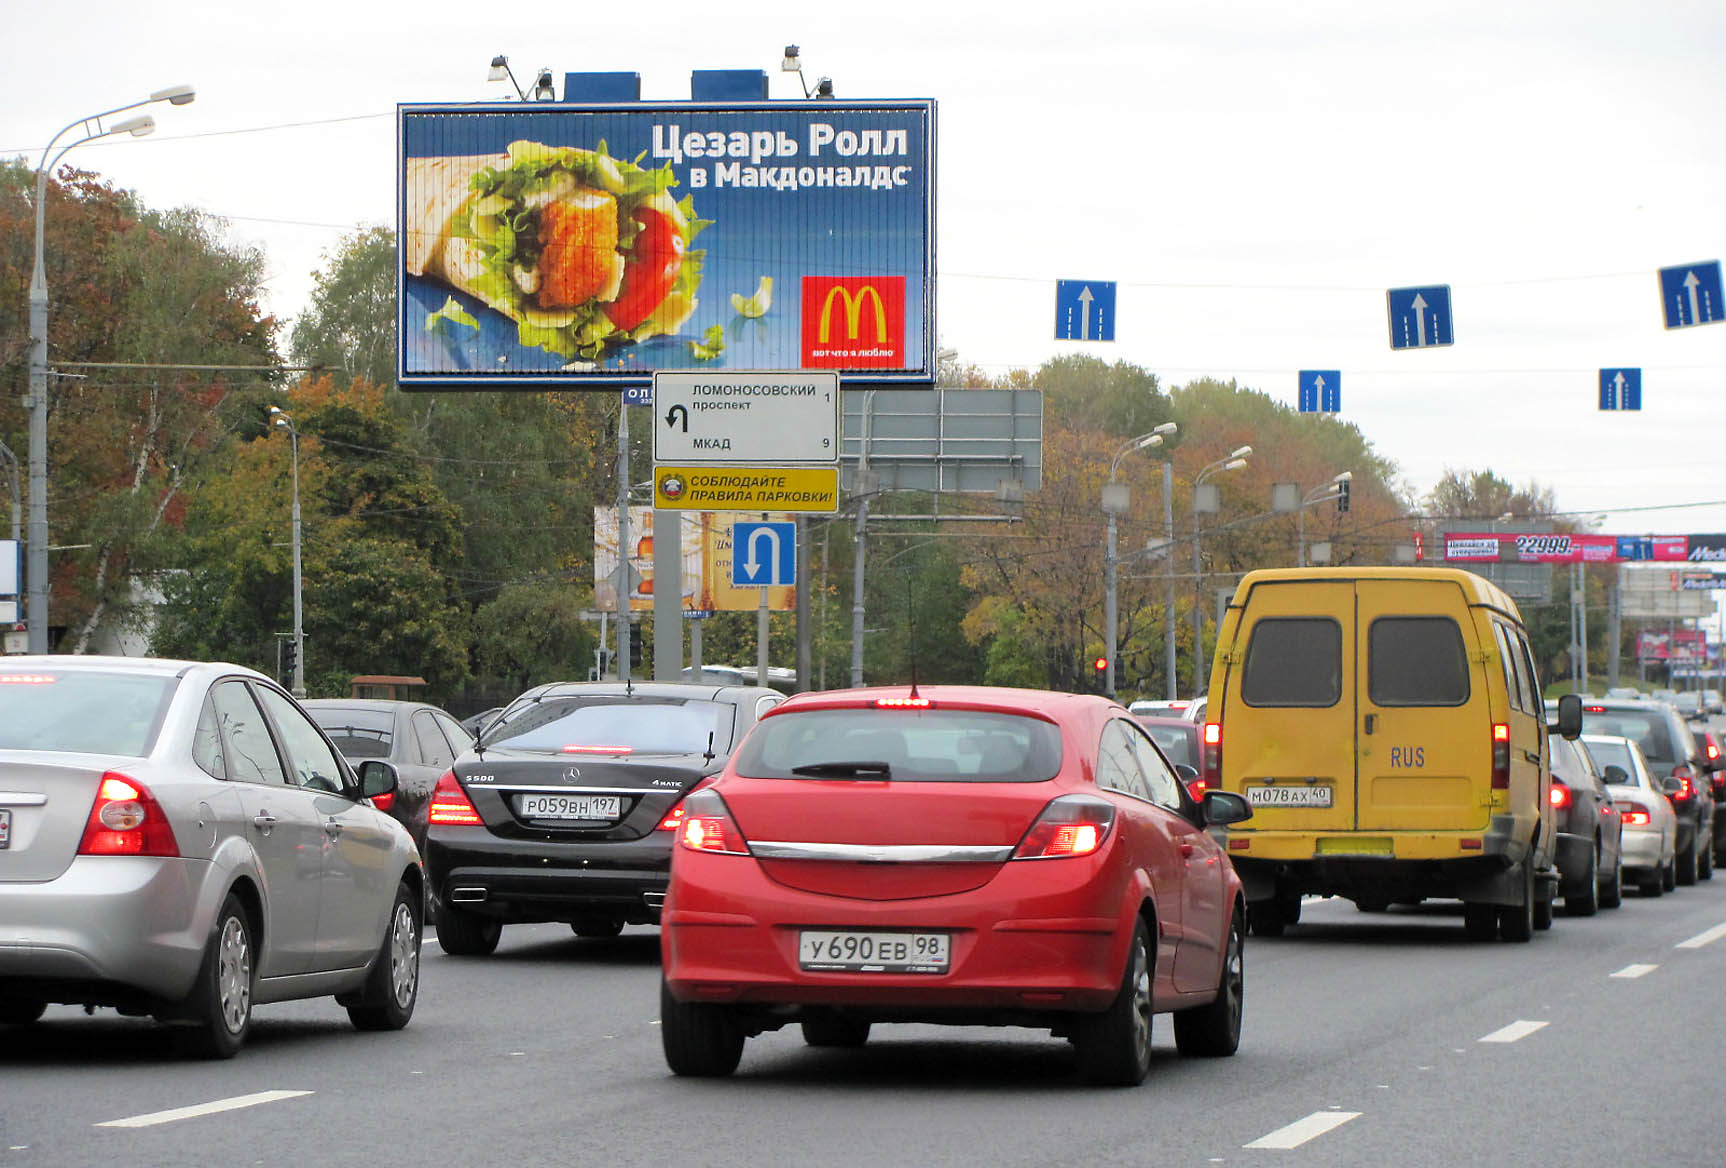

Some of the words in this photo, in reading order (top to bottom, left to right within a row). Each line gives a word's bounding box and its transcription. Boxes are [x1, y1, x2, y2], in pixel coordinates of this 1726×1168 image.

[652, 124, 798, 164] Цезарь
[809, 123, 908, 156] Ролл
[690, 167, 707, 188] в
[714, 162, 909, 191] Макдоналдс
[831, 349, 848, 357] что
[858, 347, 893, 357] люблю
[692, 383, 816, 396] ЛОМОНОСОВСКИЙ
[824, 393, 831, 403] 1
[692, 401, 751, 411] проспект
[692, 438, 731, 450] МКАД
[823, 438, 830, 448] 9
[690, 475, 787, 489] СОБЛЮДАЙТЕ
[690, 490, 752, 502] ПРАВИЛА
[756, 491, 833, 503] ПАРКОВКИ!
[1391, 746, 1425, 768] RUS
[592, 797, 615, 811] 197
[916, 937, 939, 955] 98
